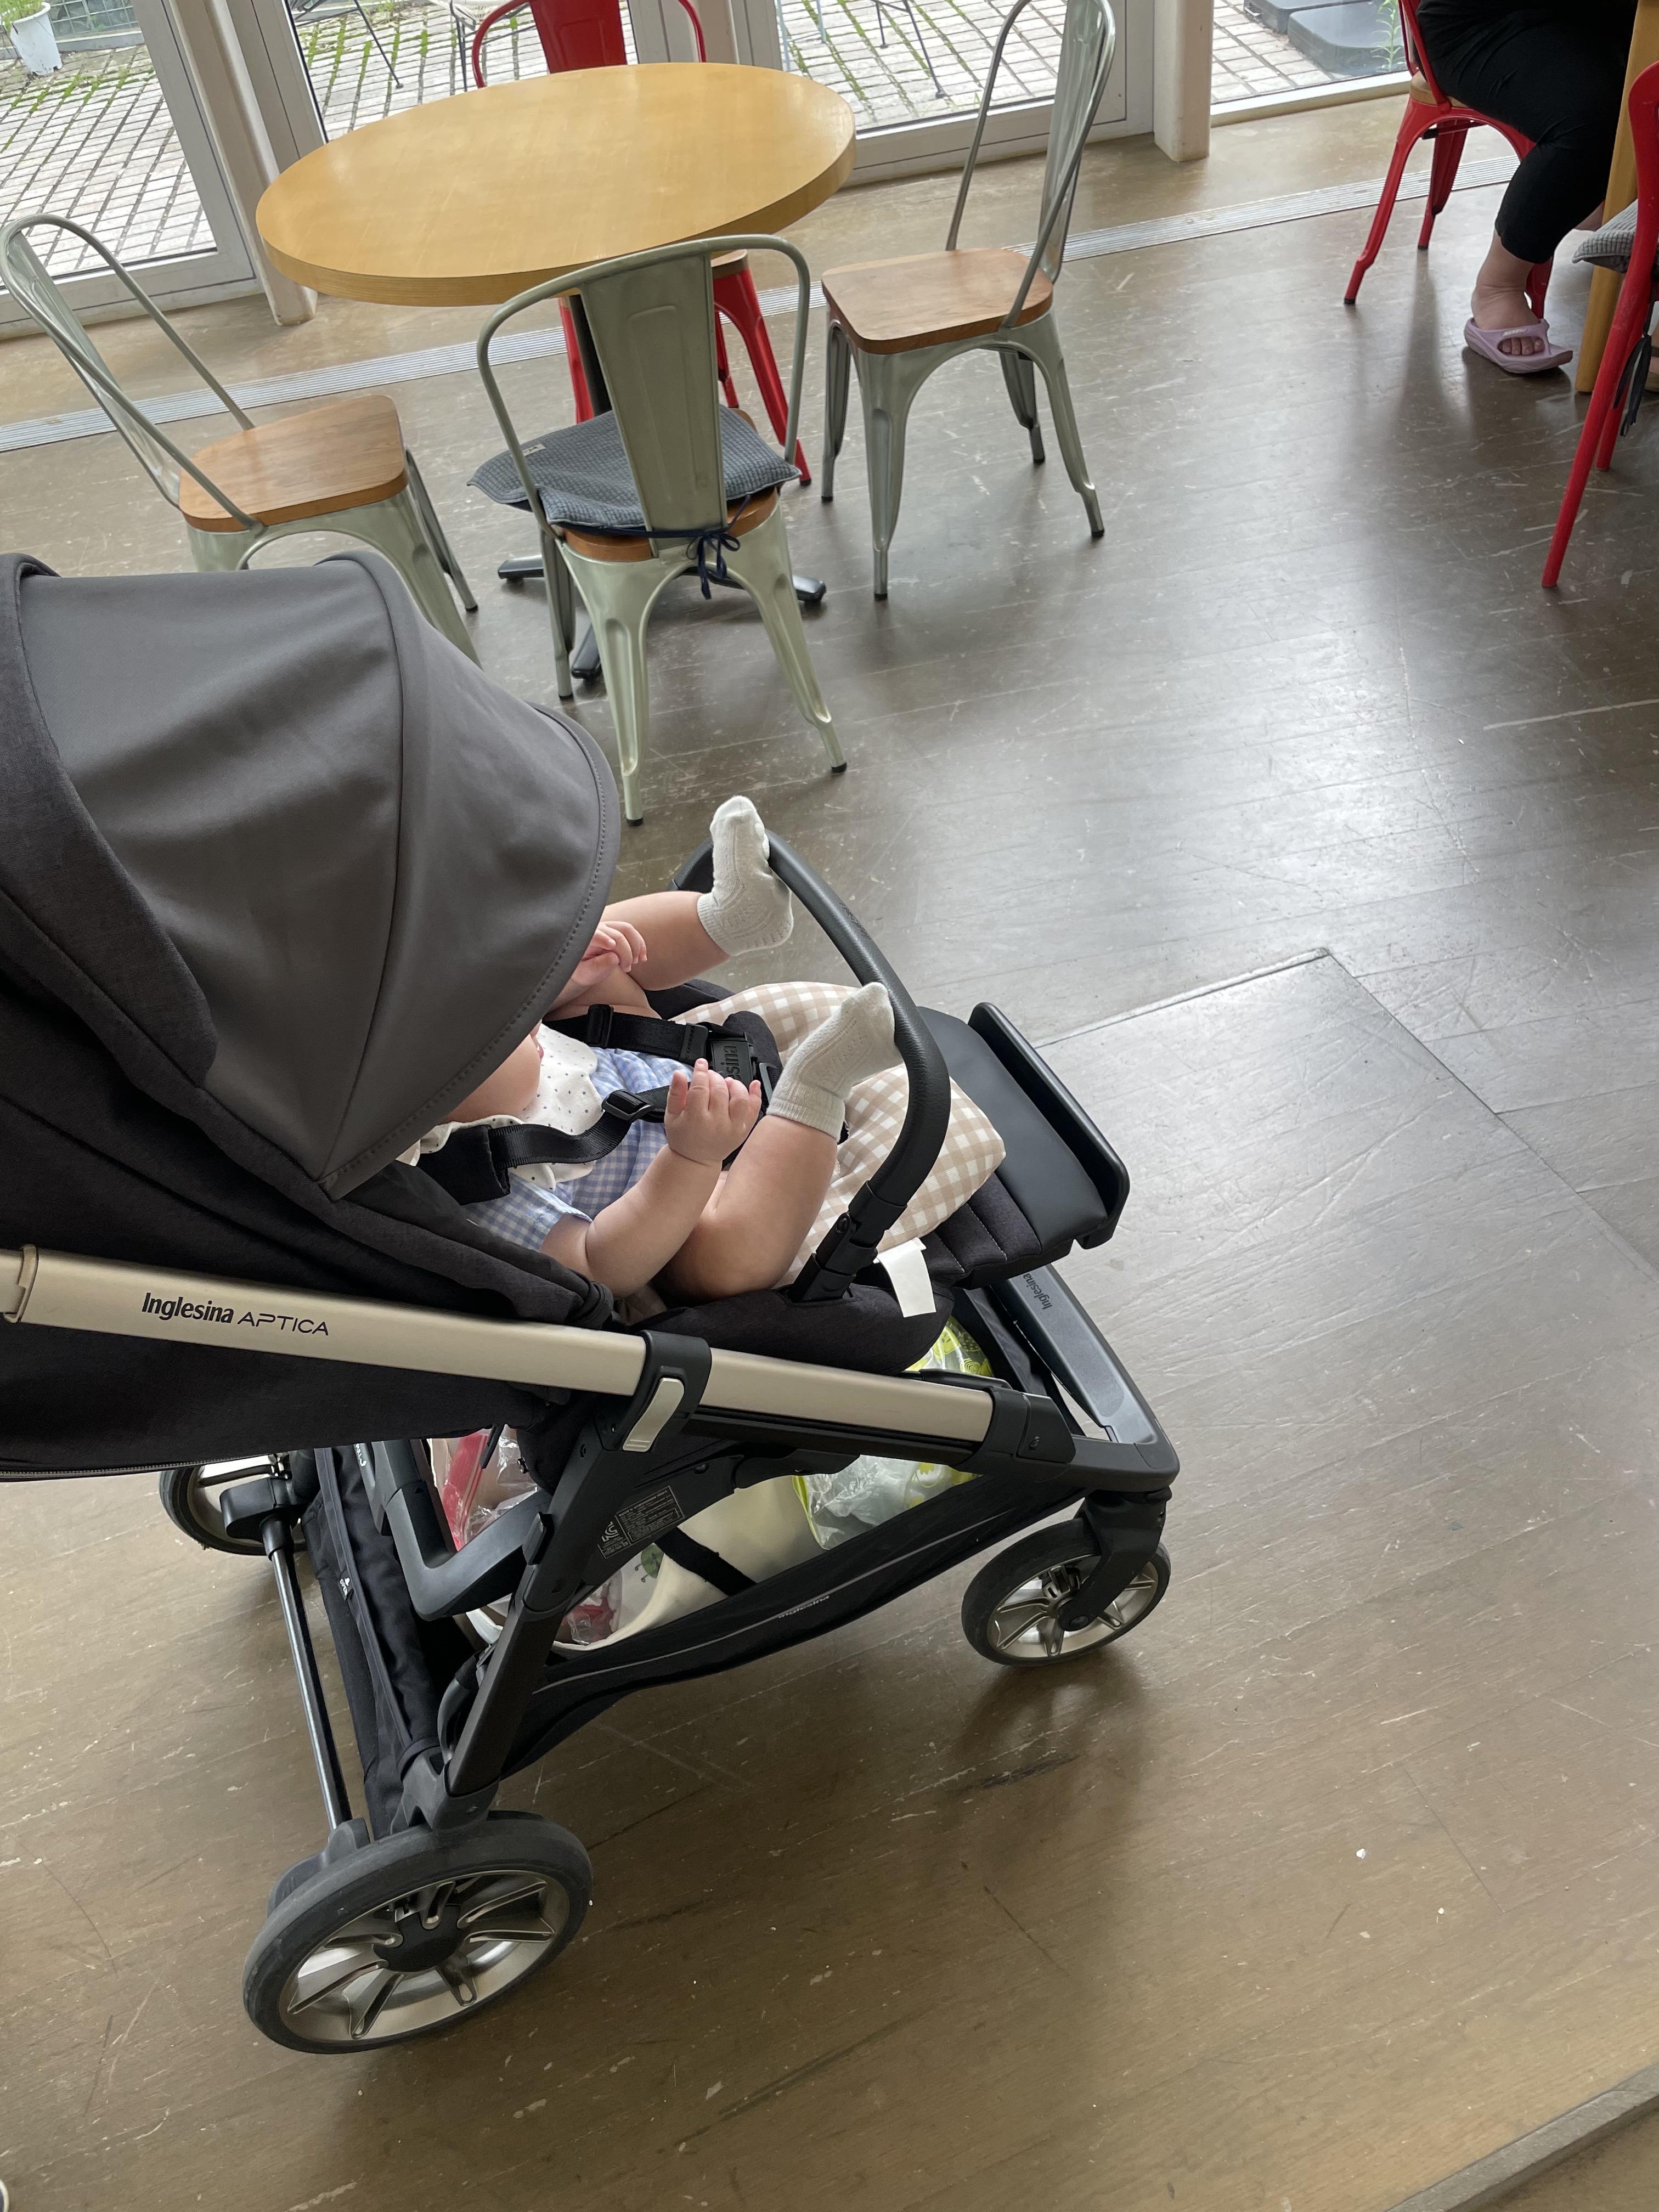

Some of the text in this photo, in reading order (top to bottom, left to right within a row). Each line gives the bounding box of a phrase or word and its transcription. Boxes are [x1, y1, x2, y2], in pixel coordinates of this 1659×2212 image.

[1023, 1273, 1053, 1310] Inglesina
[142, 1292, 329, 1336] Inglesina APTICA
